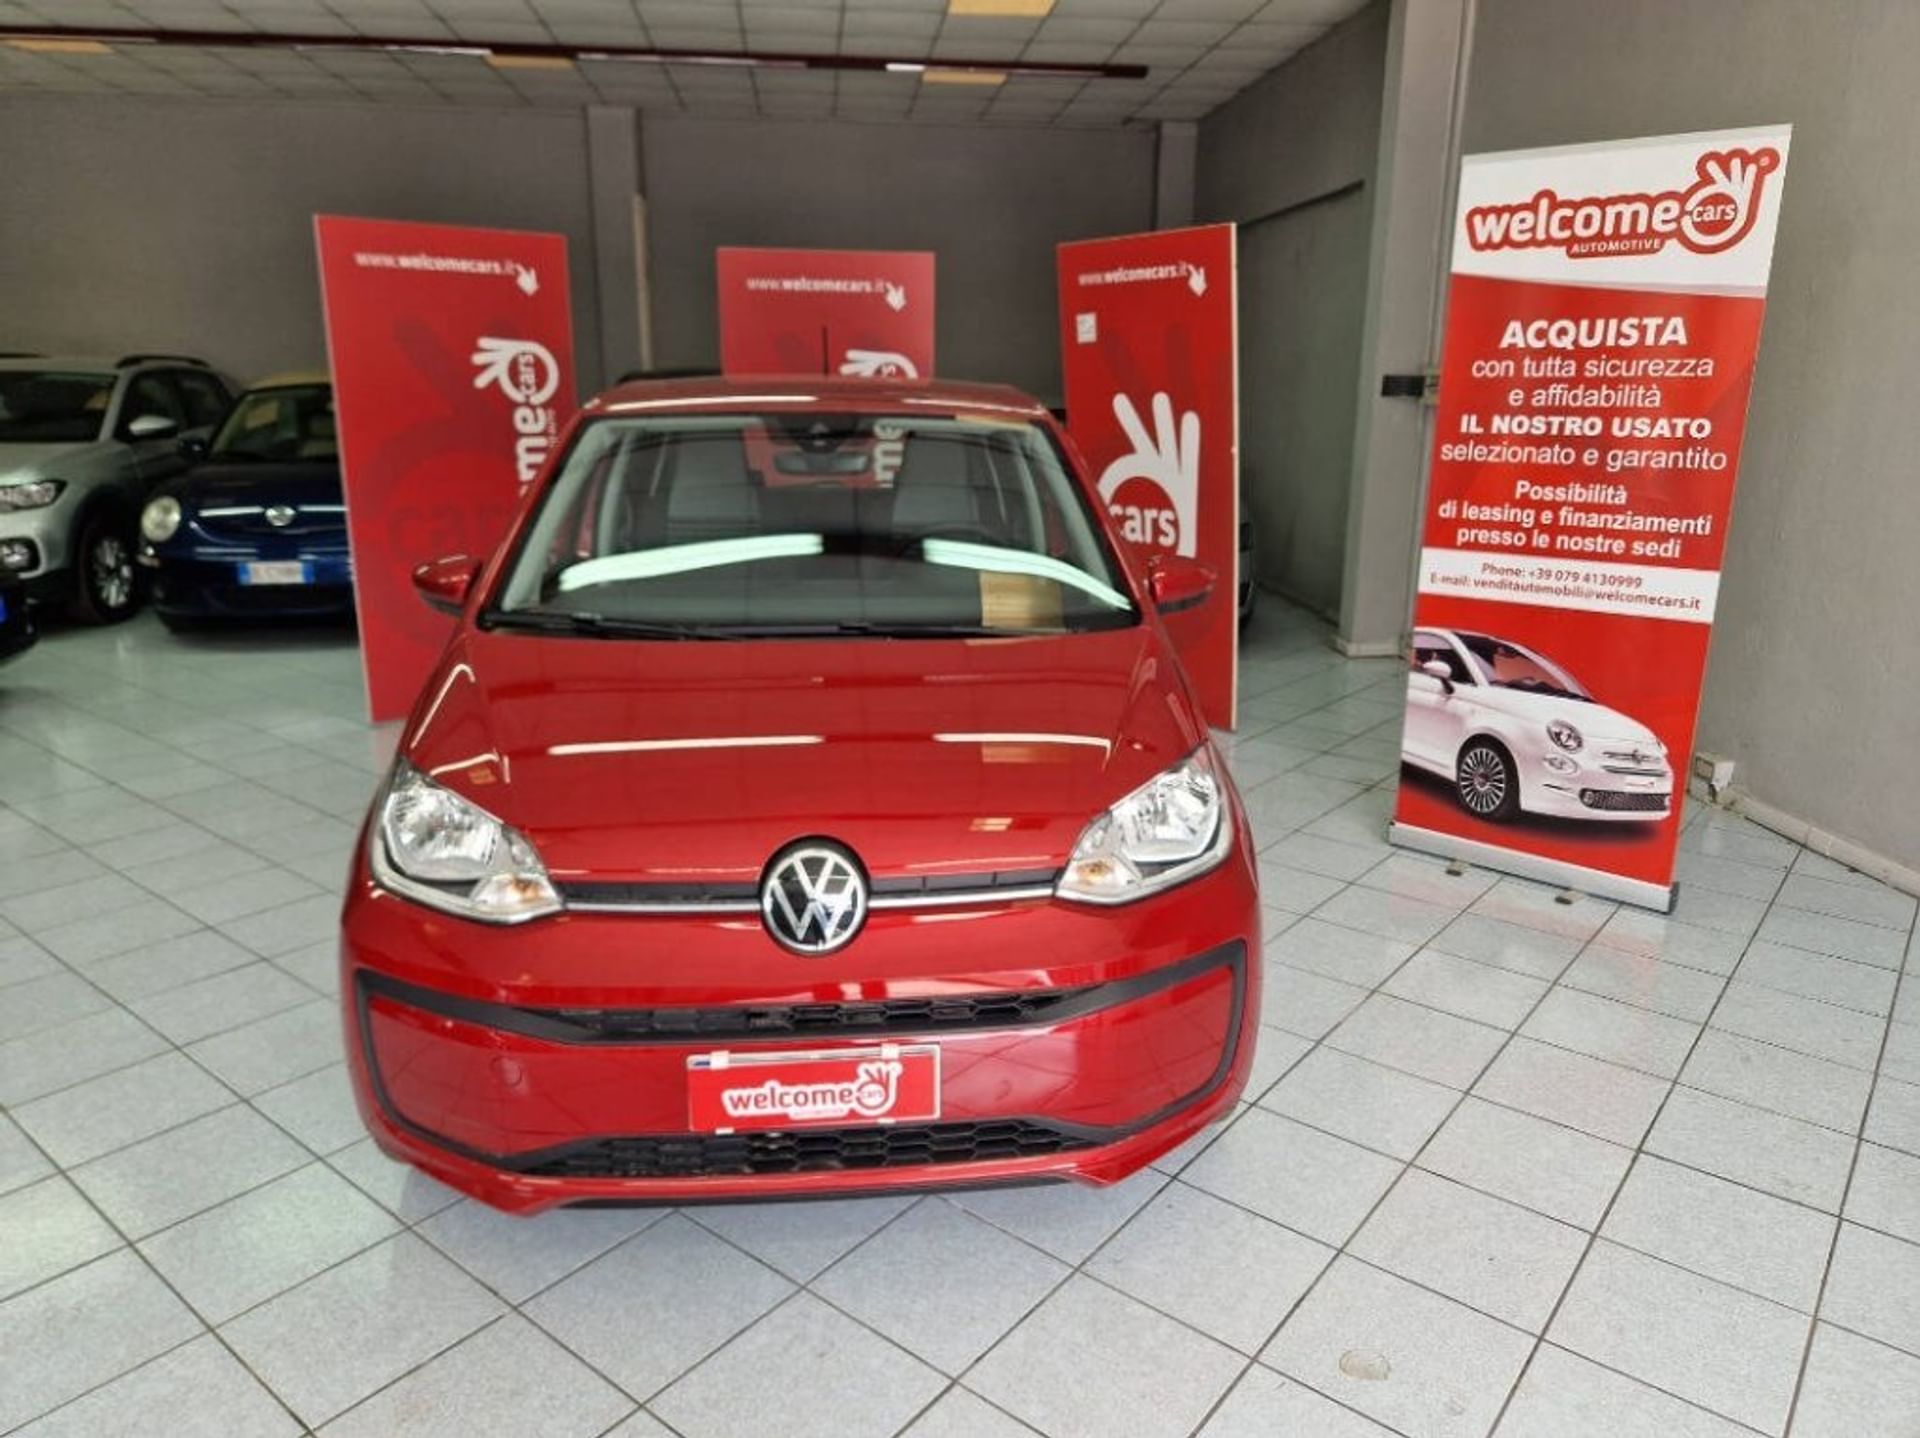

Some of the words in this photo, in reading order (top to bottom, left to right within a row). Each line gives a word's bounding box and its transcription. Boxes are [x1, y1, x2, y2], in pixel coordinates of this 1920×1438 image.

[1471, 200, 1680, 245] welcome
[1691, 202, 1737, 223] cars
[1570, 238, 1662, 255] AUTOMOTIVE
[354, 252, 515, 276] www.welcomecars.it
[1078, 260, 1188, 286] www.welcomecars.it
[746, 277, 885, 294] www.welcomecars.it
[1499, 316, 1688, 350] ACQUISTA
[518, 353, 537, 395] cars
[1471, 359, 1514, 379] con
[1522, 356, 1577, 379] tutta
[1584, 355, 1715, 378] sicurezza
[1508, 388, 1525, 407] e
[1531, 383, 1662, 408] affidabilità
[1460, 414, 1484, 434] IL
[1490, 414, 1603, 437] NOSTRO
[1610, 416, 1712, 439] USATO
[1440, 439, 1576, 466] selezionato
[1581, 447, 1600, 466] e
[1605, 444, 1728, 472] garantito
[1514, 479, 1628, 505] Possibilità
[1437, 499, 1457, 519] di
[1461, 501, 1536, 528] leasing
[1540, 508, 1554, 525] e
[1557, 506, 1713, 536] finanziamenti
[1455, 526, 1527, 547] presso
[1531, 528, 1550, 549] le
[1555, 531, 1626, 554] nostre
[1630, 536, 1682, 558] sedi
[1429, 572, 1471, 588] E-mail:
[1480, 561, 1525, 578] Phone:
[1528, 565, 1552, 581] +39
[1554, 569, 1580, 583] 079
[1581, 572, 1643, 588] 4130999
[728, 1086, 853, 1111] welcome
